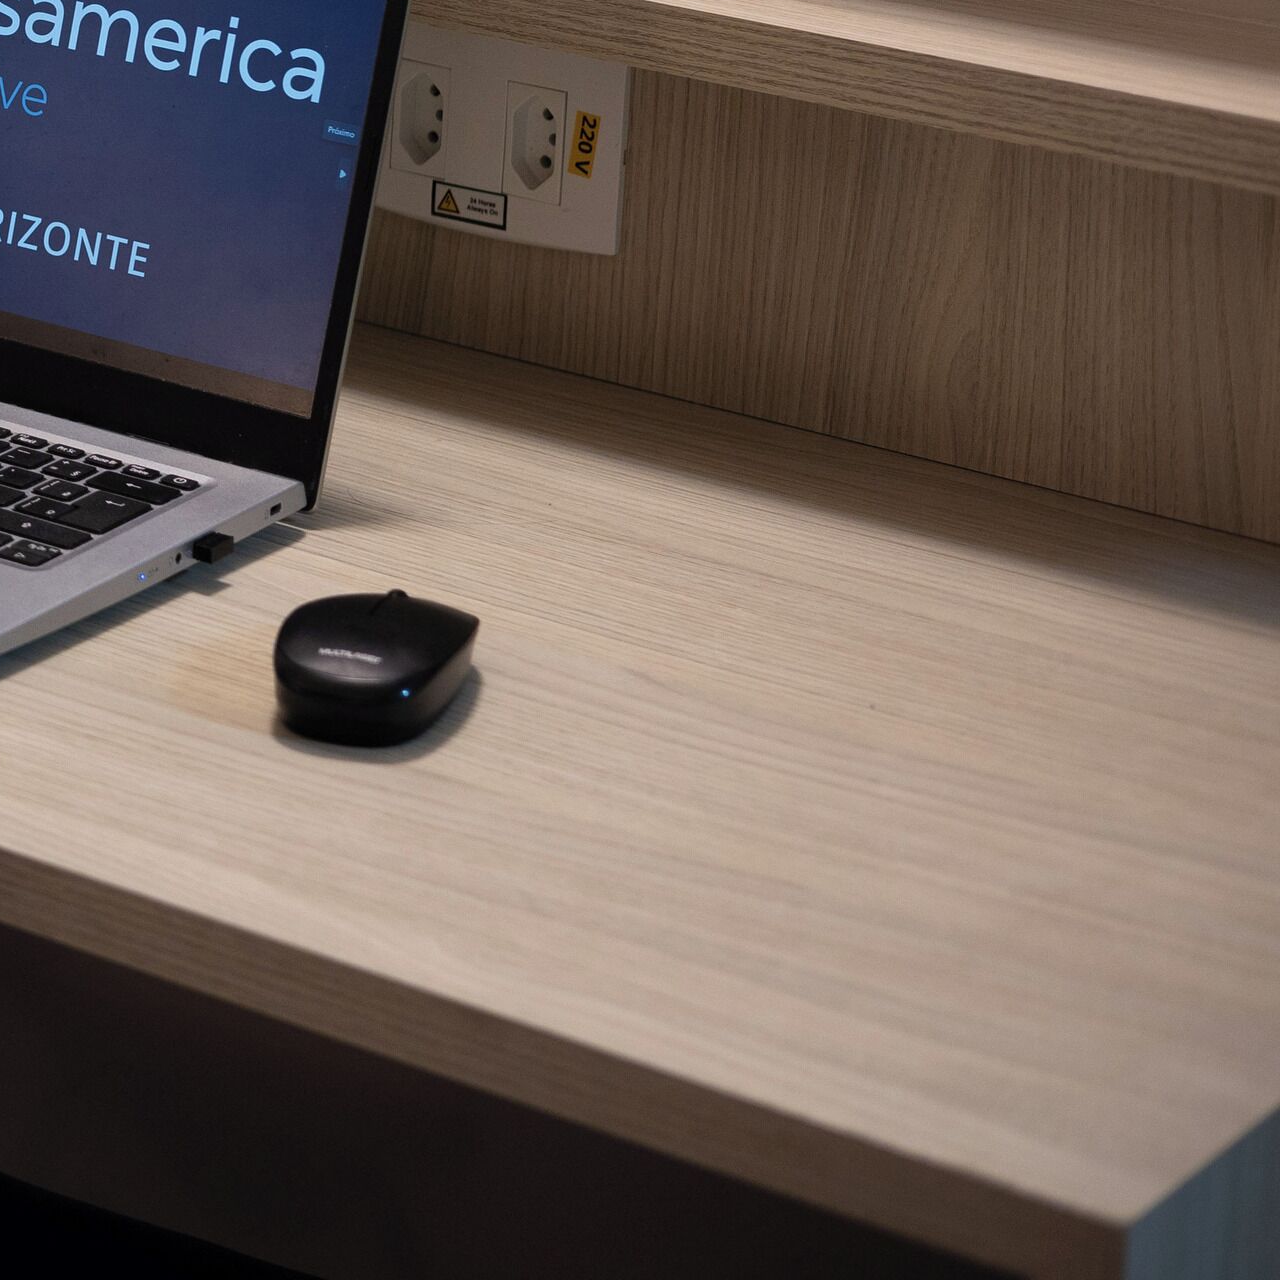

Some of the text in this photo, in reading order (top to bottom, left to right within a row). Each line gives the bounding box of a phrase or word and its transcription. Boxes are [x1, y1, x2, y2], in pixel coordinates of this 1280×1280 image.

[327, 125, 356, 138] Próximo
[574, 115, 597, 175] 220 V
